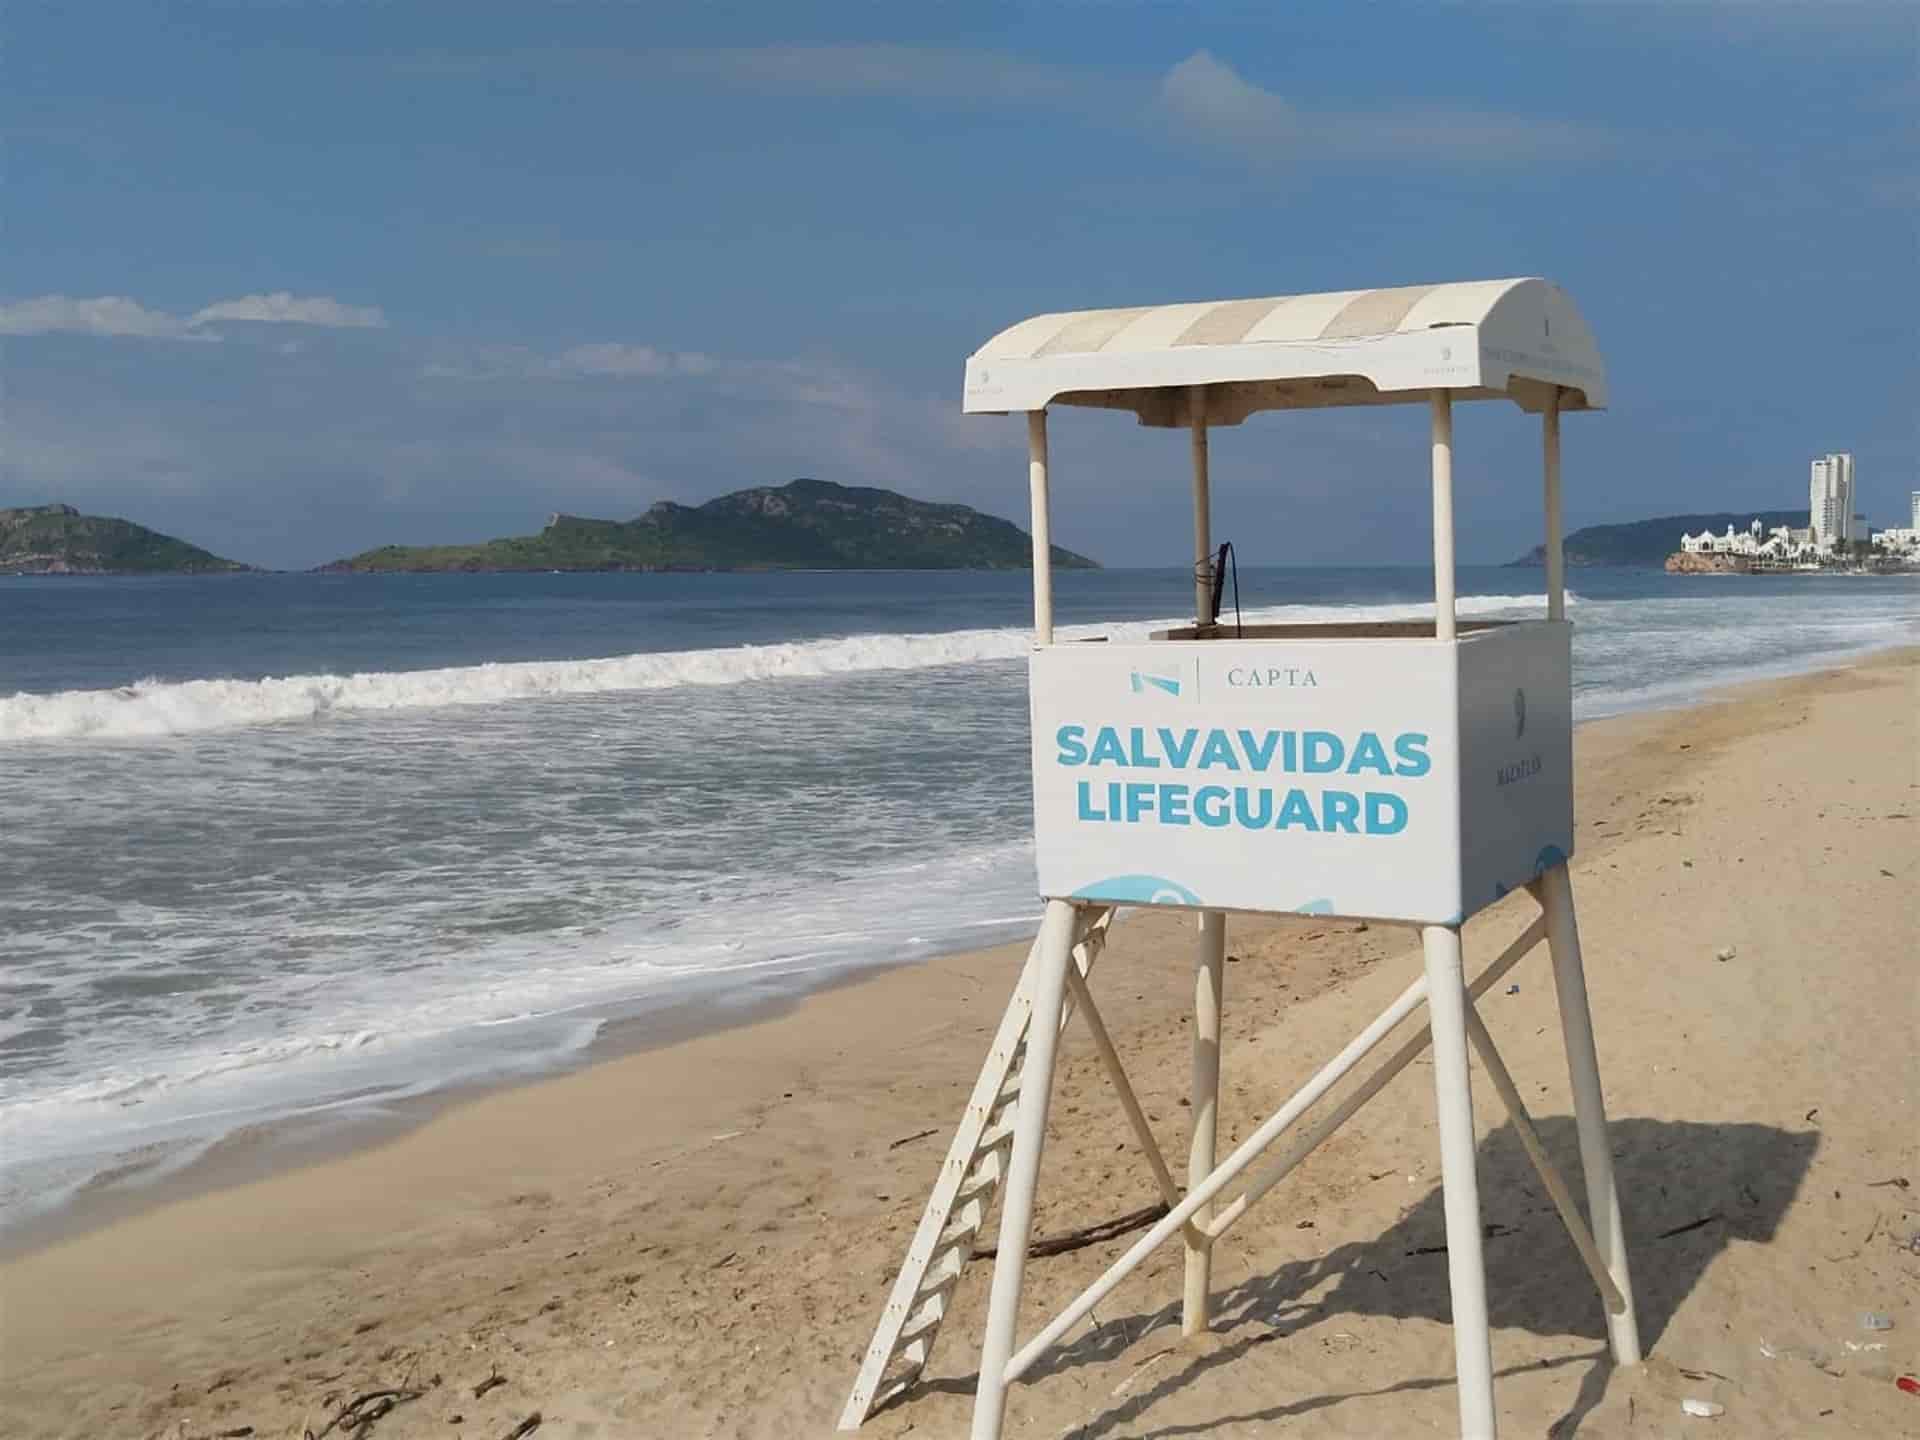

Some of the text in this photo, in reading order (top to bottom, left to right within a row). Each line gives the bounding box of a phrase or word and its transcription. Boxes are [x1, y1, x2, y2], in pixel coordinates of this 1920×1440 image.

[1228, 668, 1318, 687] CAPTA
[1056, 726, 1431, 777] SALVAVIDAS
[1078, 782, 1408, 835] LIFEGUARD
